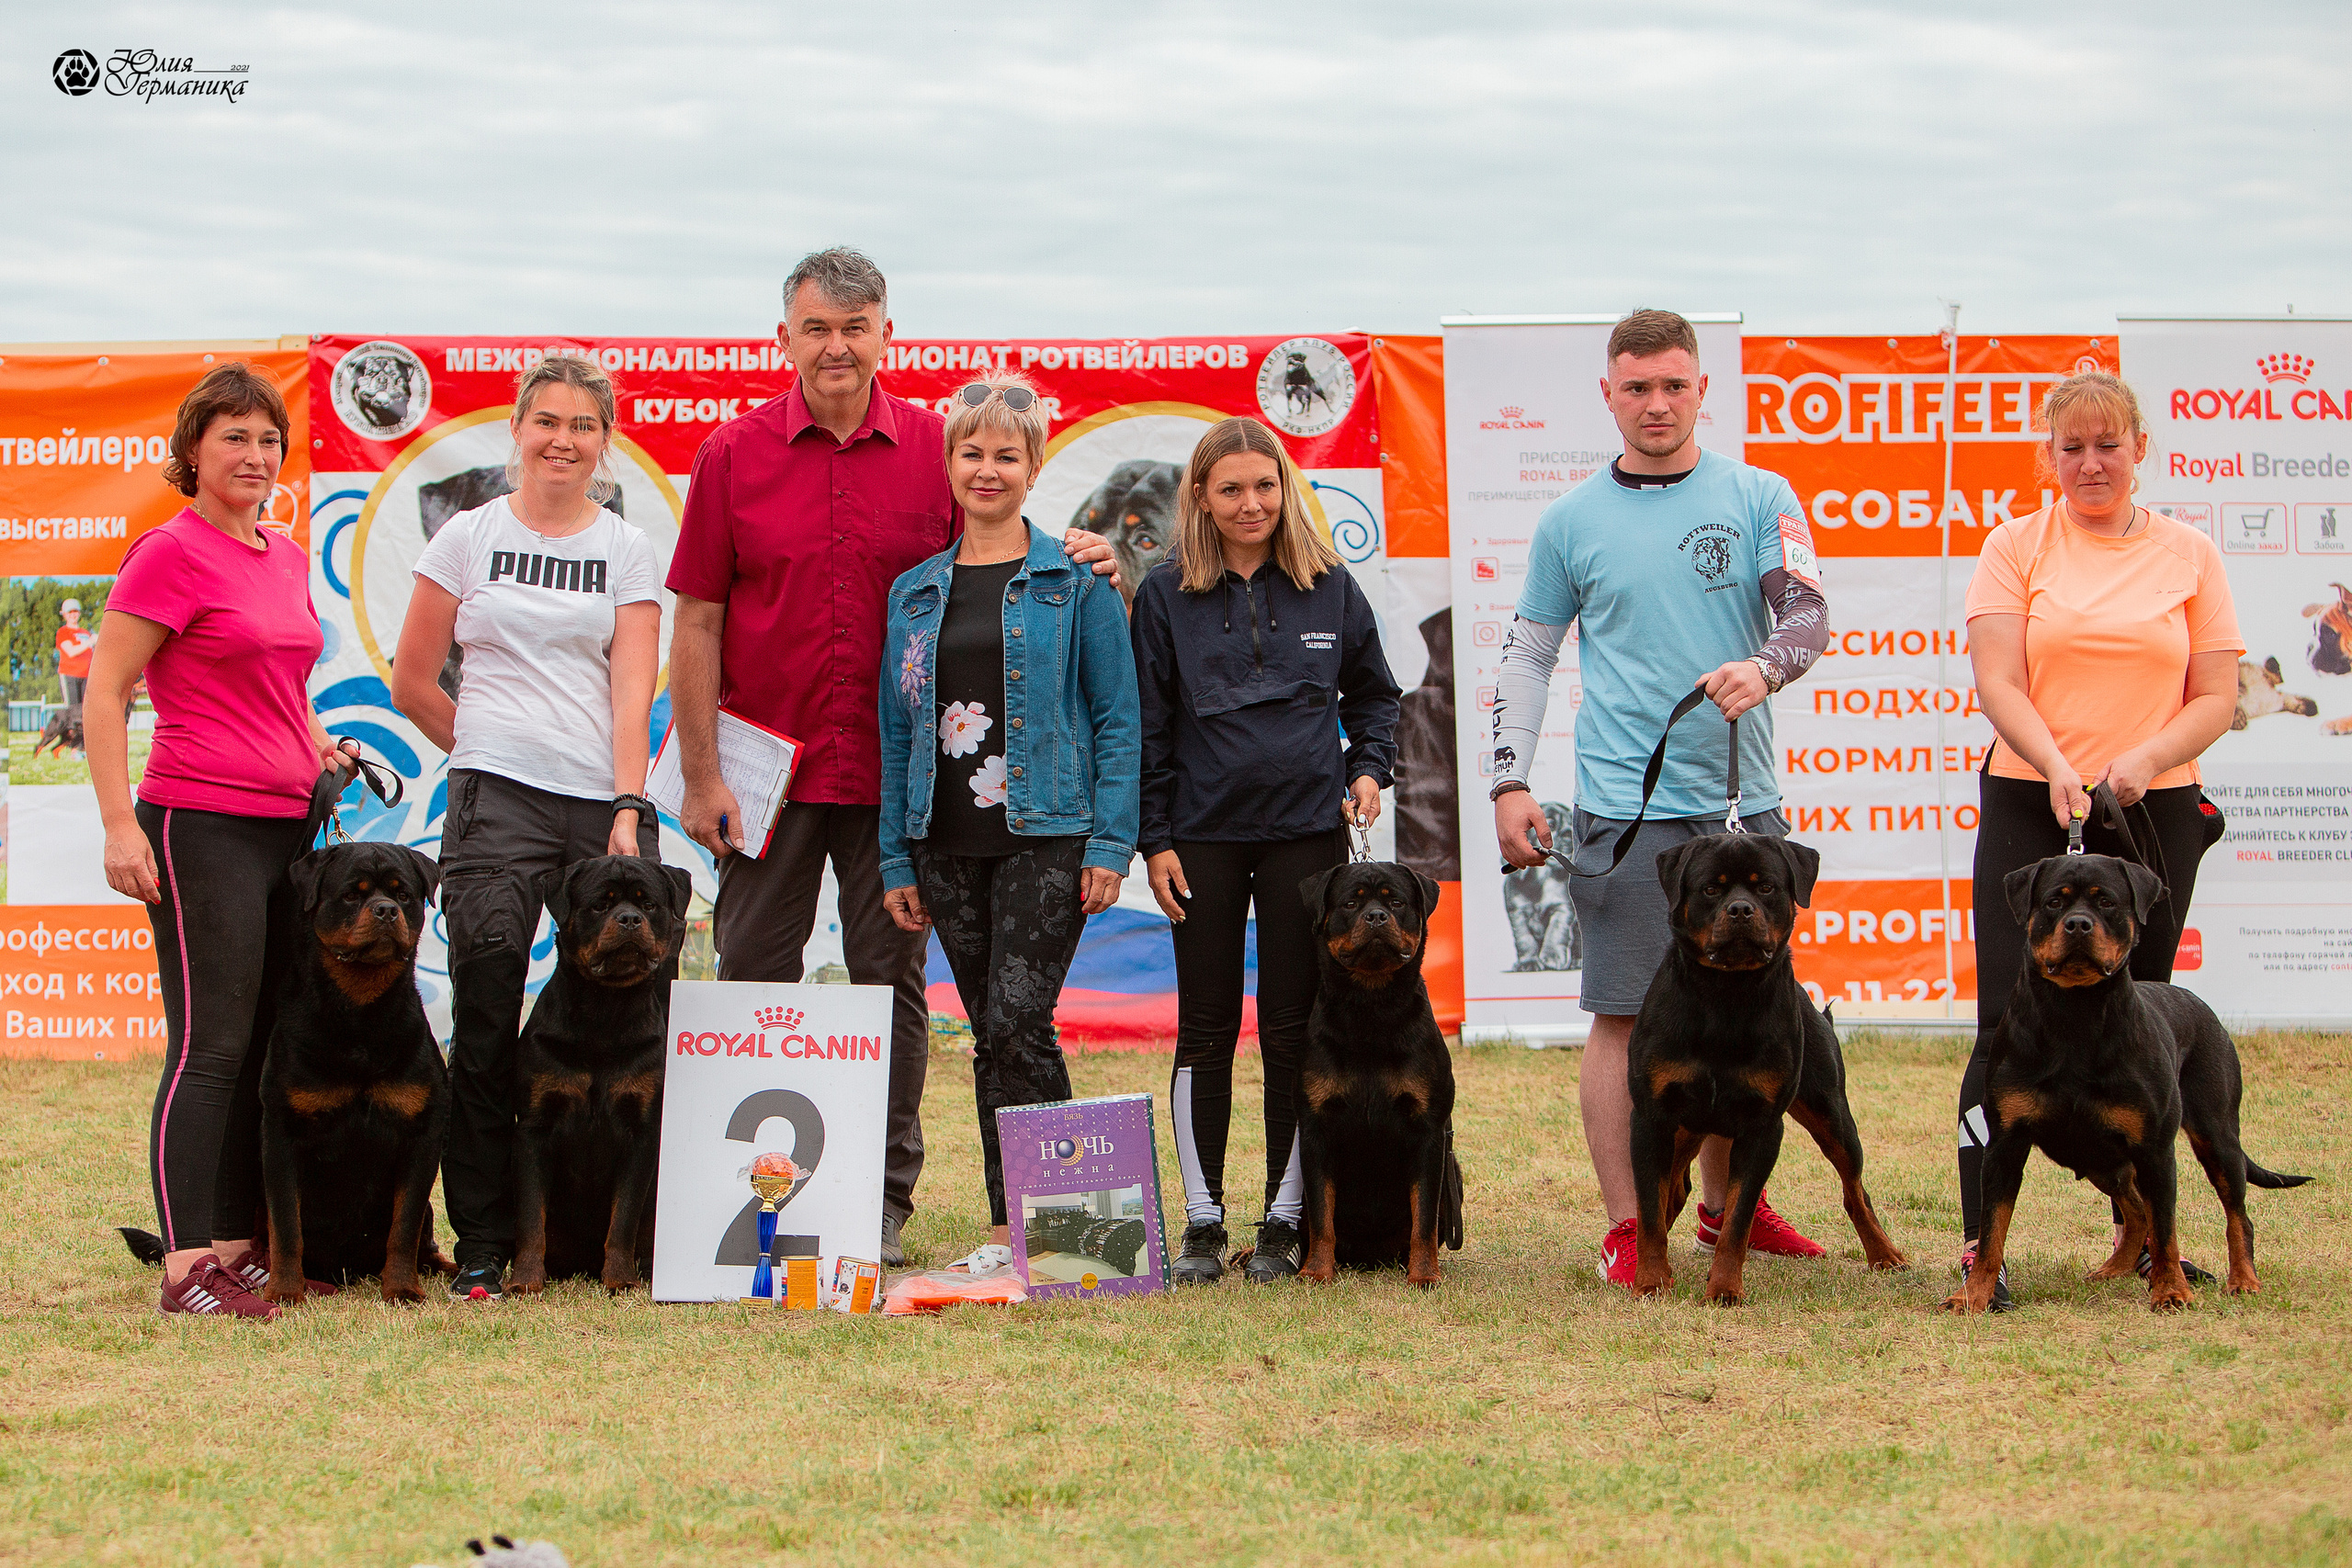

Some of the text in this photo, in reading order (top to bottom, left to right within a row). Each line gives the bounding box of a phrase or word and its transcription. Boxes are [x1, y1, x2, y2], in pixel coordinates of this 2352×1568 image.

[1020, 339, 1250, 370] РОТВЕЙЛЕРОВ
[1303, 339, 1337, 355] КЛУБ
[1338, 356, 1353, 408] РОССИИ
[634, 398, 741, 423] КУБОК
[2170, 388, 2283, 421] ROYAL
[1479, 421, 1544, 429] ROYAL CANIN
[1520, 451, 1621, 465] ПРИСОЕДИНЯ
[2169, 452, 2245, 483] Royal
[1520, 469, 1564, 481] ROYAL
[1468, 490, 1562, 502] ПРЕИМУЩЕСТВА
[1812, 489, 2017, 529] СОБАК
[0, 516, 127, 540] выставки
[1678, 524, 1741, 551] ROTTWEILER
[2227, 540, 2256, 549] Online
[2313, 540, 2344, 550] Забота
[489, 550, 606, 593] PUMA
[1300, 632, 1337, 641] SAN FRANCISCO
[1823, 630, 1971, 656] СИОН
[1786, 747, 1984, 773] КОРМЛЕН
[2245, 786, 2269, 799] ДЛЯ
[2272, 786, 2302, 797] СЕБЯ
[1870, 805, 1980, 831] ПИТО
[2222, 806, 2349, 818] ЕСТВА ПАРТНЕРСТВА
[2221, 828, 2347, 842] ДИНЯЙТЕСЬ К КЛУБУ
[2236, 850, 2274, 862] ROYAL
[2278, 850, 2332, 862] BREEDER
[1799, 908, 1975, 944] .PROFI
[2239, 927, 2281, 936] Получить
[2285, 927, 2335, 936] подробную
[0, 921, 153, 958] офессио
[2262, 951, 2305, 960] телефону
[0, 972, 162, 1001] ход к кор
[6, 1010, 167, 1039] Ваших пи
[676, 1031, 882, 1061] ROYAL CANIN
[1064, 1112, 1084, 1121] БЯЗЬ
[1038, 1134, 1114, 1162] НОЧЬ
[714, 1088, 826, 1268] 2
